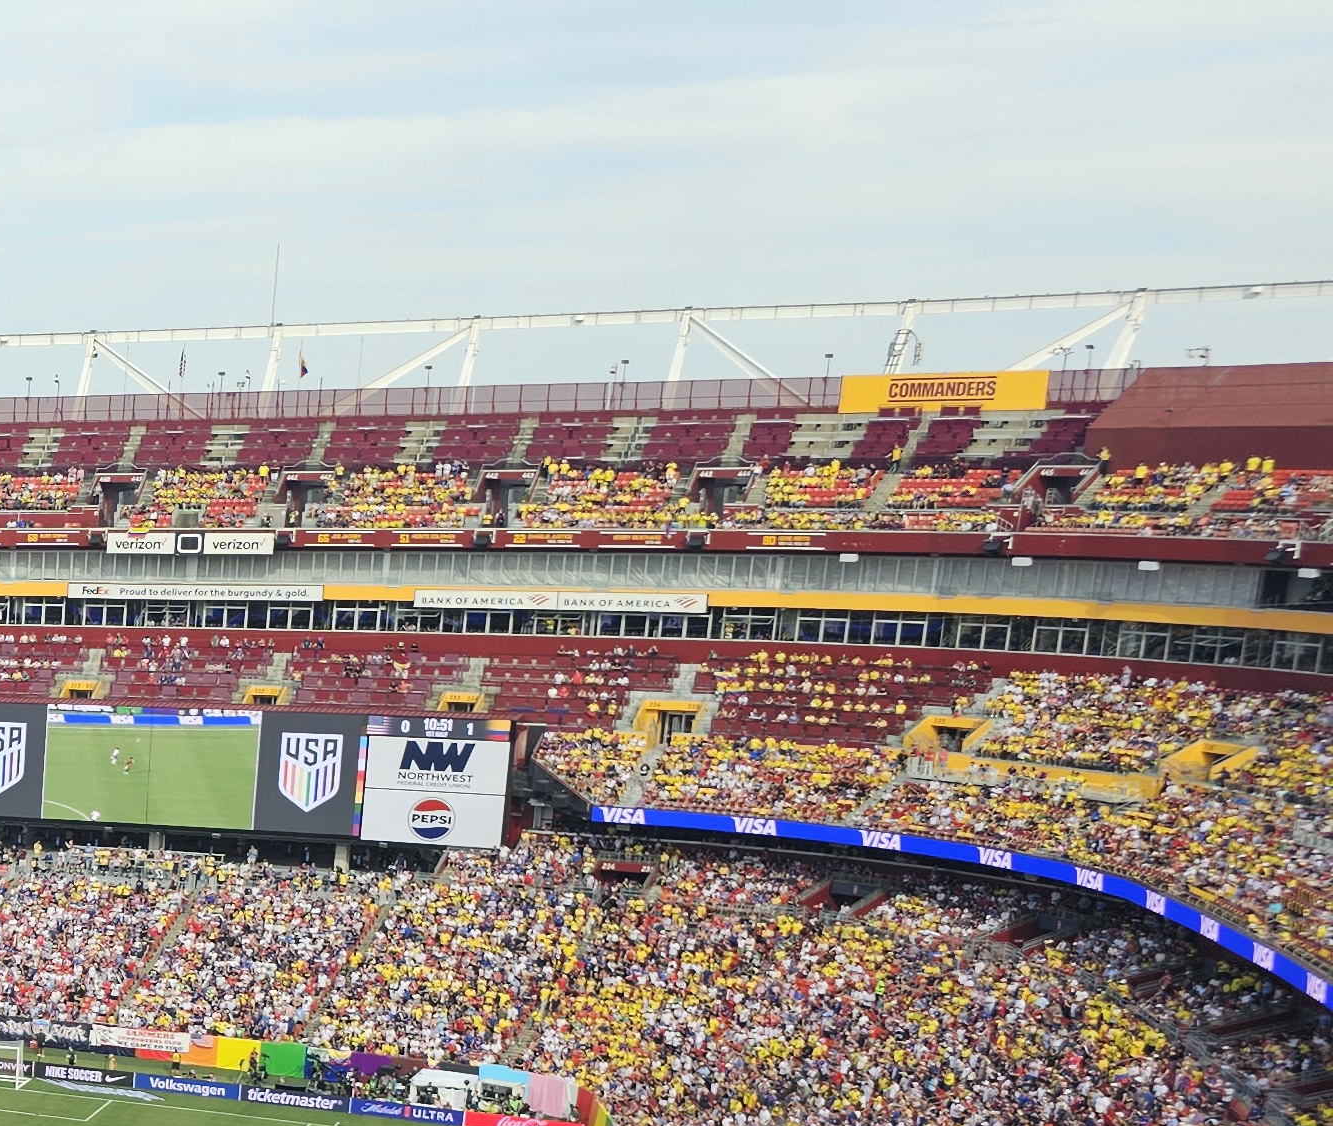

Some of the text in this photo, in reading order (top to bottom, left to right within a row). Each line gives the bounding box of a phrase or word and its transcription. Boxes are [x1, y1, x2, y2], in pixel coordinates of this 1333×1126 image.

[889, 381, 997, 398] COMMANDERS
[115, 539, 162, 550] verizon
[212, 539, 260, 550] verizon
[81, 586, 109, 596] FedEx
[119, 587, 147, 596] Proud
[148, 587, 159, 596] to
[160, 587, 192, 596] deliver
[194, 587, 208, 598] for
[208, 587, 224, 597] the
[227, 587, 275, 600] burgundy
[276, 588, 283, 597] &
[421, 597, 524, 607] BANK OF AMERICA
[564, 598, 671, 609] BANK OF AMERICA
[401, 717, 474, 736] 0 10:51 1
[286, 737, 338, 767] USA
[399, 740, 476, 773] NW
[398, 771, 473, 783] NORTHWEST
[412, 814, 452, 825] PEPSI
[600, 807, 645, 825] VISA
[733, 817, 777, 836] VISA
[859, 829, 901, 851] VISA
[977, 846, 1013, 869] VISA
[1074, 867, 1104, 891] VISA
[1145, 889, 1167, 916] VISA
[1200, 915, 1220, 942] VISA
[1253, 942, 1275, 972] VISA
[1305, 971, 1328, 1002] VISA
[45, 1065, 103, 1083] NIKE SOCCER
[149, 1077, 226, 1097] Volkswagen
[247, 1087, 338, 1110] ticketmaster
[412, 1109, 455, 1123] ULTRA
